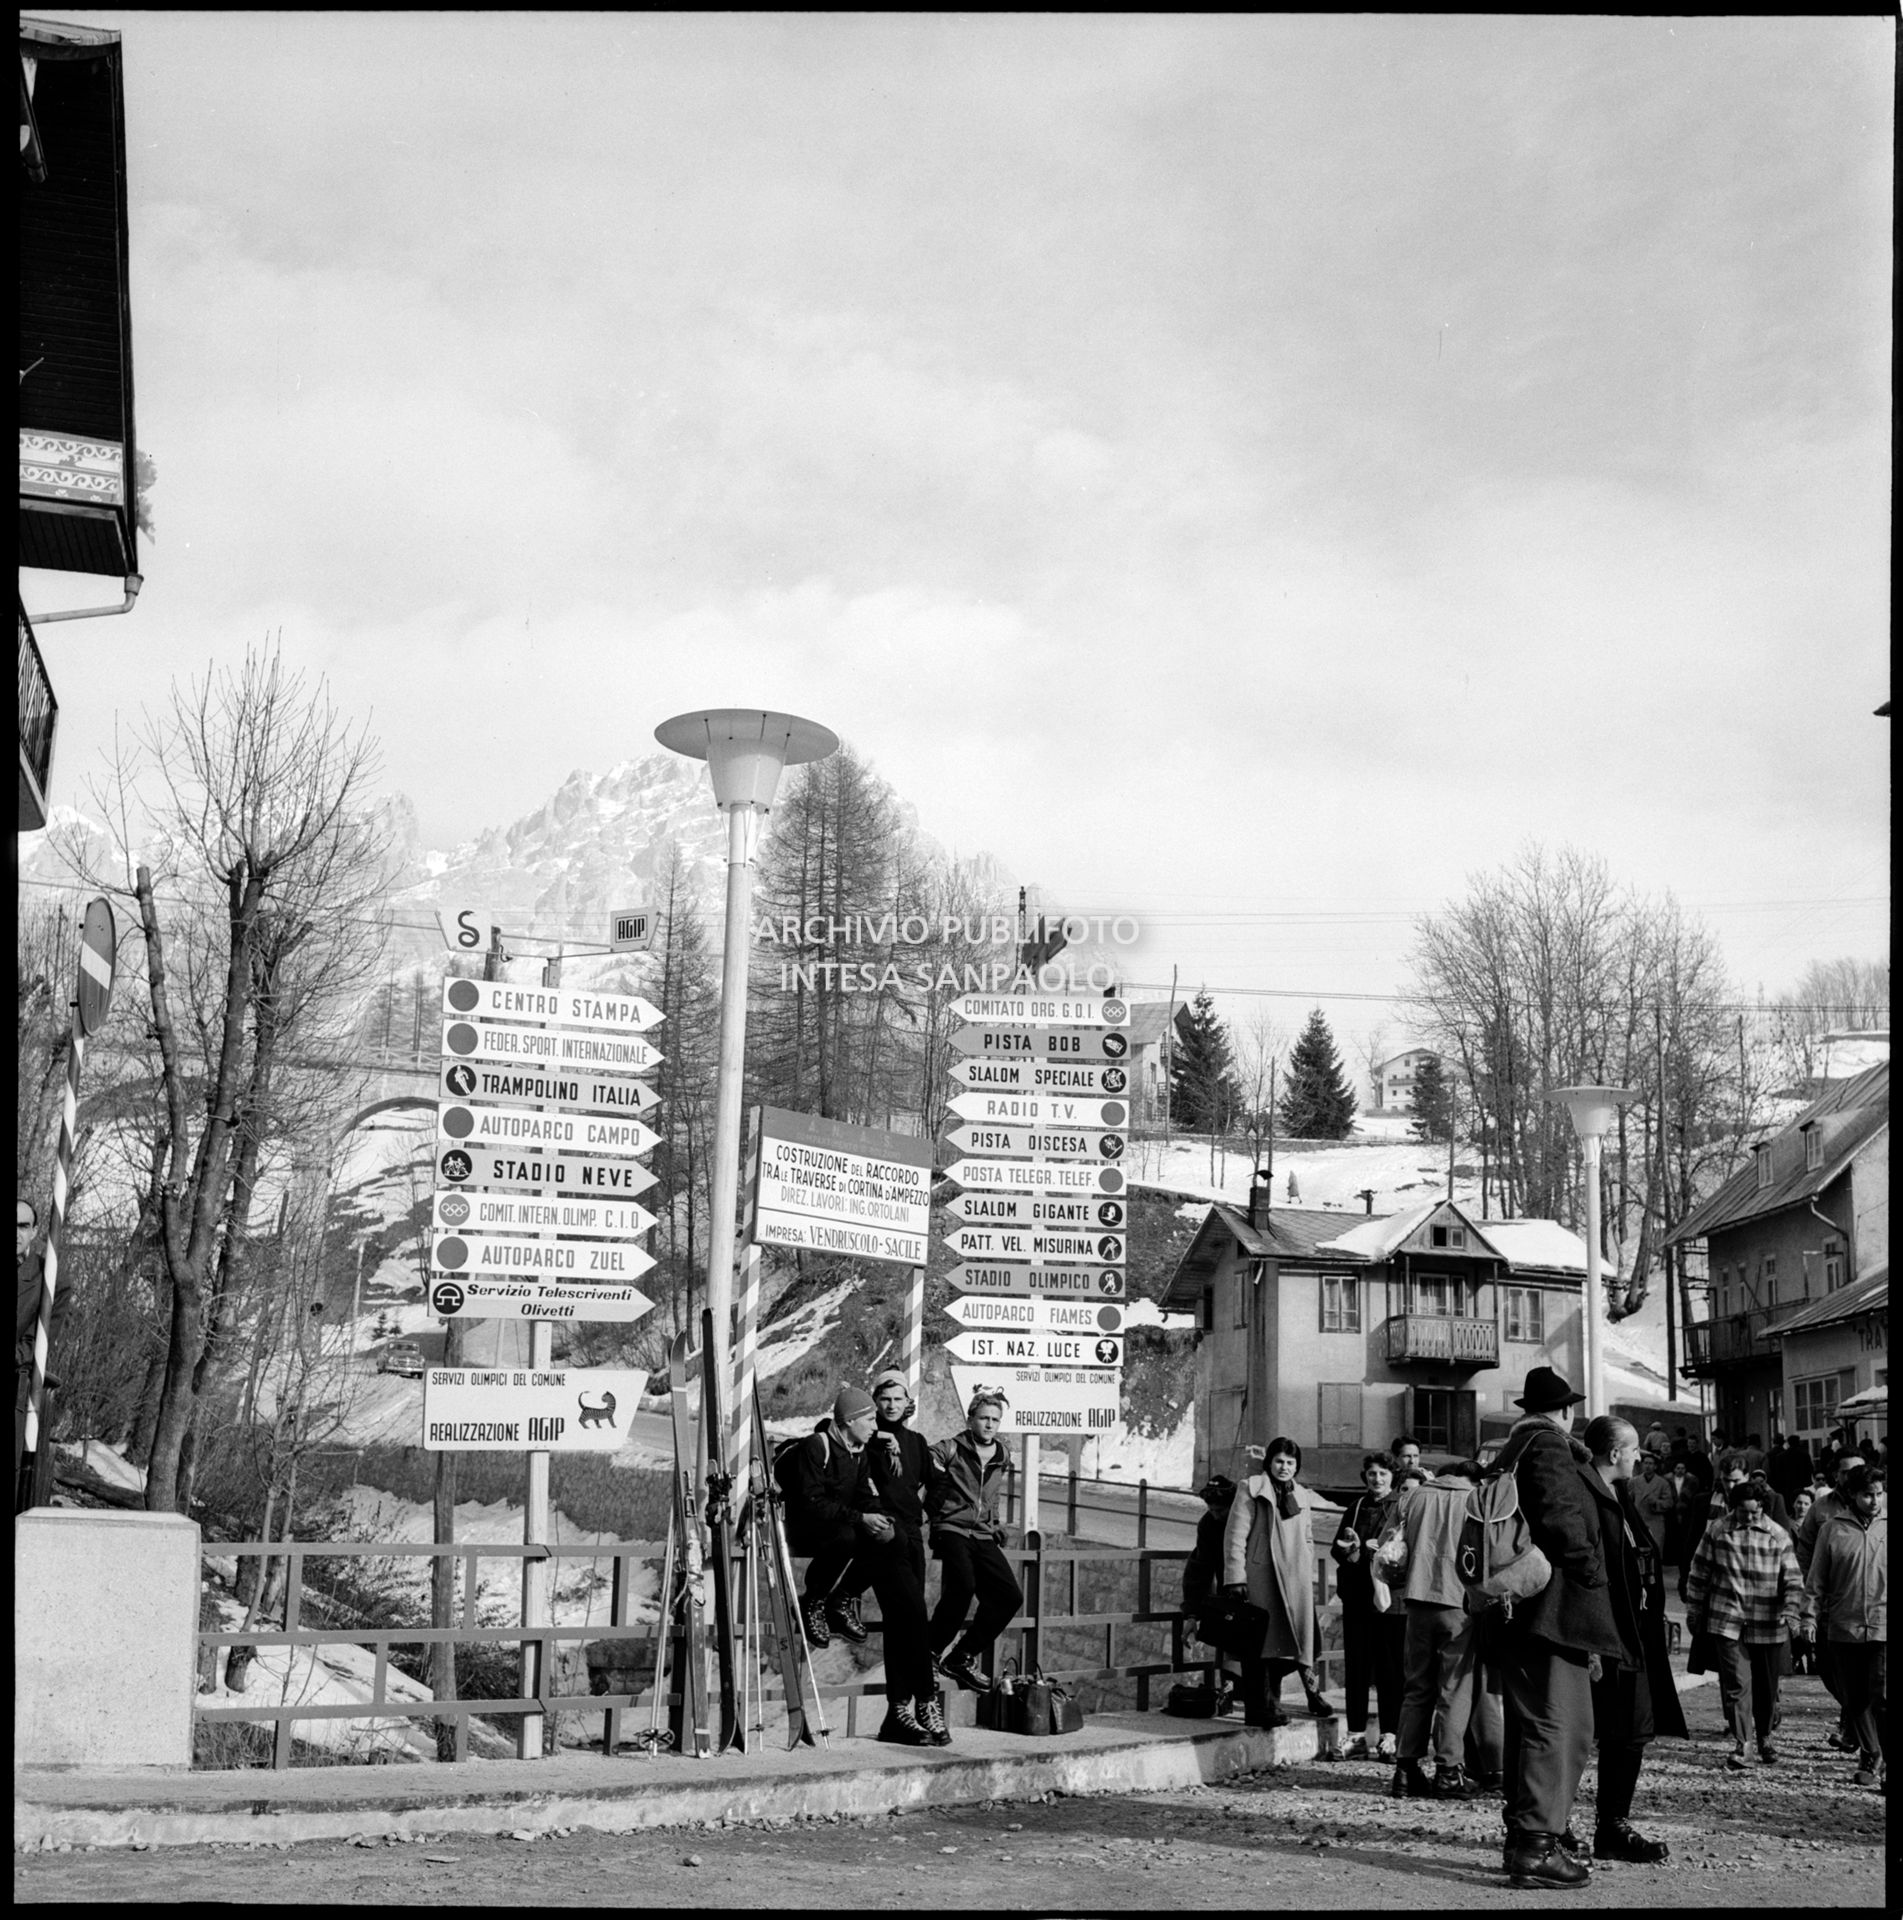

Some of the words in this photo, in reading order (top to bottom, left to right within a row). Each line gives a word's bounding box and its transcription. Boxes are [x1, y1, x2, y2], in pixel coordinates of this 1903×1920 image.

[618, 918, 645, 939] AGIP
[492, 991, 557, 1014] CENTRO
[572, 999, 641, 1023] STAMPA
[965, 999, 1024, 1016] COMITATO
[1031, 1003, 1058, 1018] ORG.
[562, 1041, 648, 1064] INTERNAZIONALE
[984, 1034, 1032, 1050] PISTA
[1049, 1036, 1080, 1051] BOB
[969, 1066, 1019, 1083] SLALOM
[1035, 1069, 1093, 1086] SPECIALE
[482, 1074, 578, 1101] TRAMPOLINO
[593, 1085, 641, 1106] ITALIA
[987, 1101, 1038, 1117] RADIO
[1051, 1104, 1077, 1119] T.V.
[480, 1116, 573, 1141] AUTOPARCO
[588, 1125, 640, 1146] CAMPO
[972, 1132, 1010, 1149] PISTA
[1029, 1135, 1087, 1152] DISCESA
[494, 1160, 565, 1182] STADIO
[583, 1166, 632, 1187] NEVE
[777, 1145, 848, 1174] COSTRUZIONE
[866, 1162, 918, 1185] RACCORDO
[763, 1162, 780, 1180] TRA
[791, 1168, 836, 1191] TRAVERSE
[848, 1179, 882, 1198] CORTINA
[964, 1166, 1002, 1182] POSTA
[1009, 1169, 1055, 1185] TELEGR.
[1058, 1171, 1095, 1186] TELEF.
[868, 1202, 909, 1222] ORTOLANI
[965, 1199, 1017, 1217] SLALOM
[1033, 1204, 1089, 1220] GIGANTE
[766, 1225, 806, 1242] IMPRESA:
[961, 1234, 994, 1251] PATT.
[1002, 1237, 1026, 1252] VEL.
[1034, 1238, 1093, 1255] MISURINA
[482, 1246, 574, 1268] AUTOPARCO
[590, 1251, 625, 1270] ZUEL
[965, 1269, 1010, 1287] STADIO
[1029, 1272, 1089, 1289] OLIMPICO
[467, 1284, 531, 1297] Servizio
[538, 1287, 631, 1301] Telescriventi
[521, 1304, 575, 1317] Olivetti
[962, 1303, 1034, 1322] AUTOPARCO
[1050, 1308, 1091, 1325] FIAMES
[972, 1340, 999, 1355] IST.
[1007, 1342, 1039, 1357] NAZ.
[1048, 1343, 1080, 1358] LUCE
[432, 1372, 464, 1385] SERVIZI
[471, 1373, 507, 1386] OLIMPICI
[514, 1373, 526, 1386] DEL
[532, 1374, 565, 1386] COMUNE
[1016, 1371, 1040, 1382] SERVIZI
[1045, 1372, 1071, 1382] OLIMPICI
[1076, 1373, 1086, 1383] DEL
[1090, 1373, 1115, 1384] COMUNE
[1016, 1411, 1081, 1427] REALIZZAZIONE
[1089, 1408, 1115, 1428] AGIP
[430, 1423, 519, 1442] REALIZZAZIONE
[529, 1417, 564, 1441] AGIP
